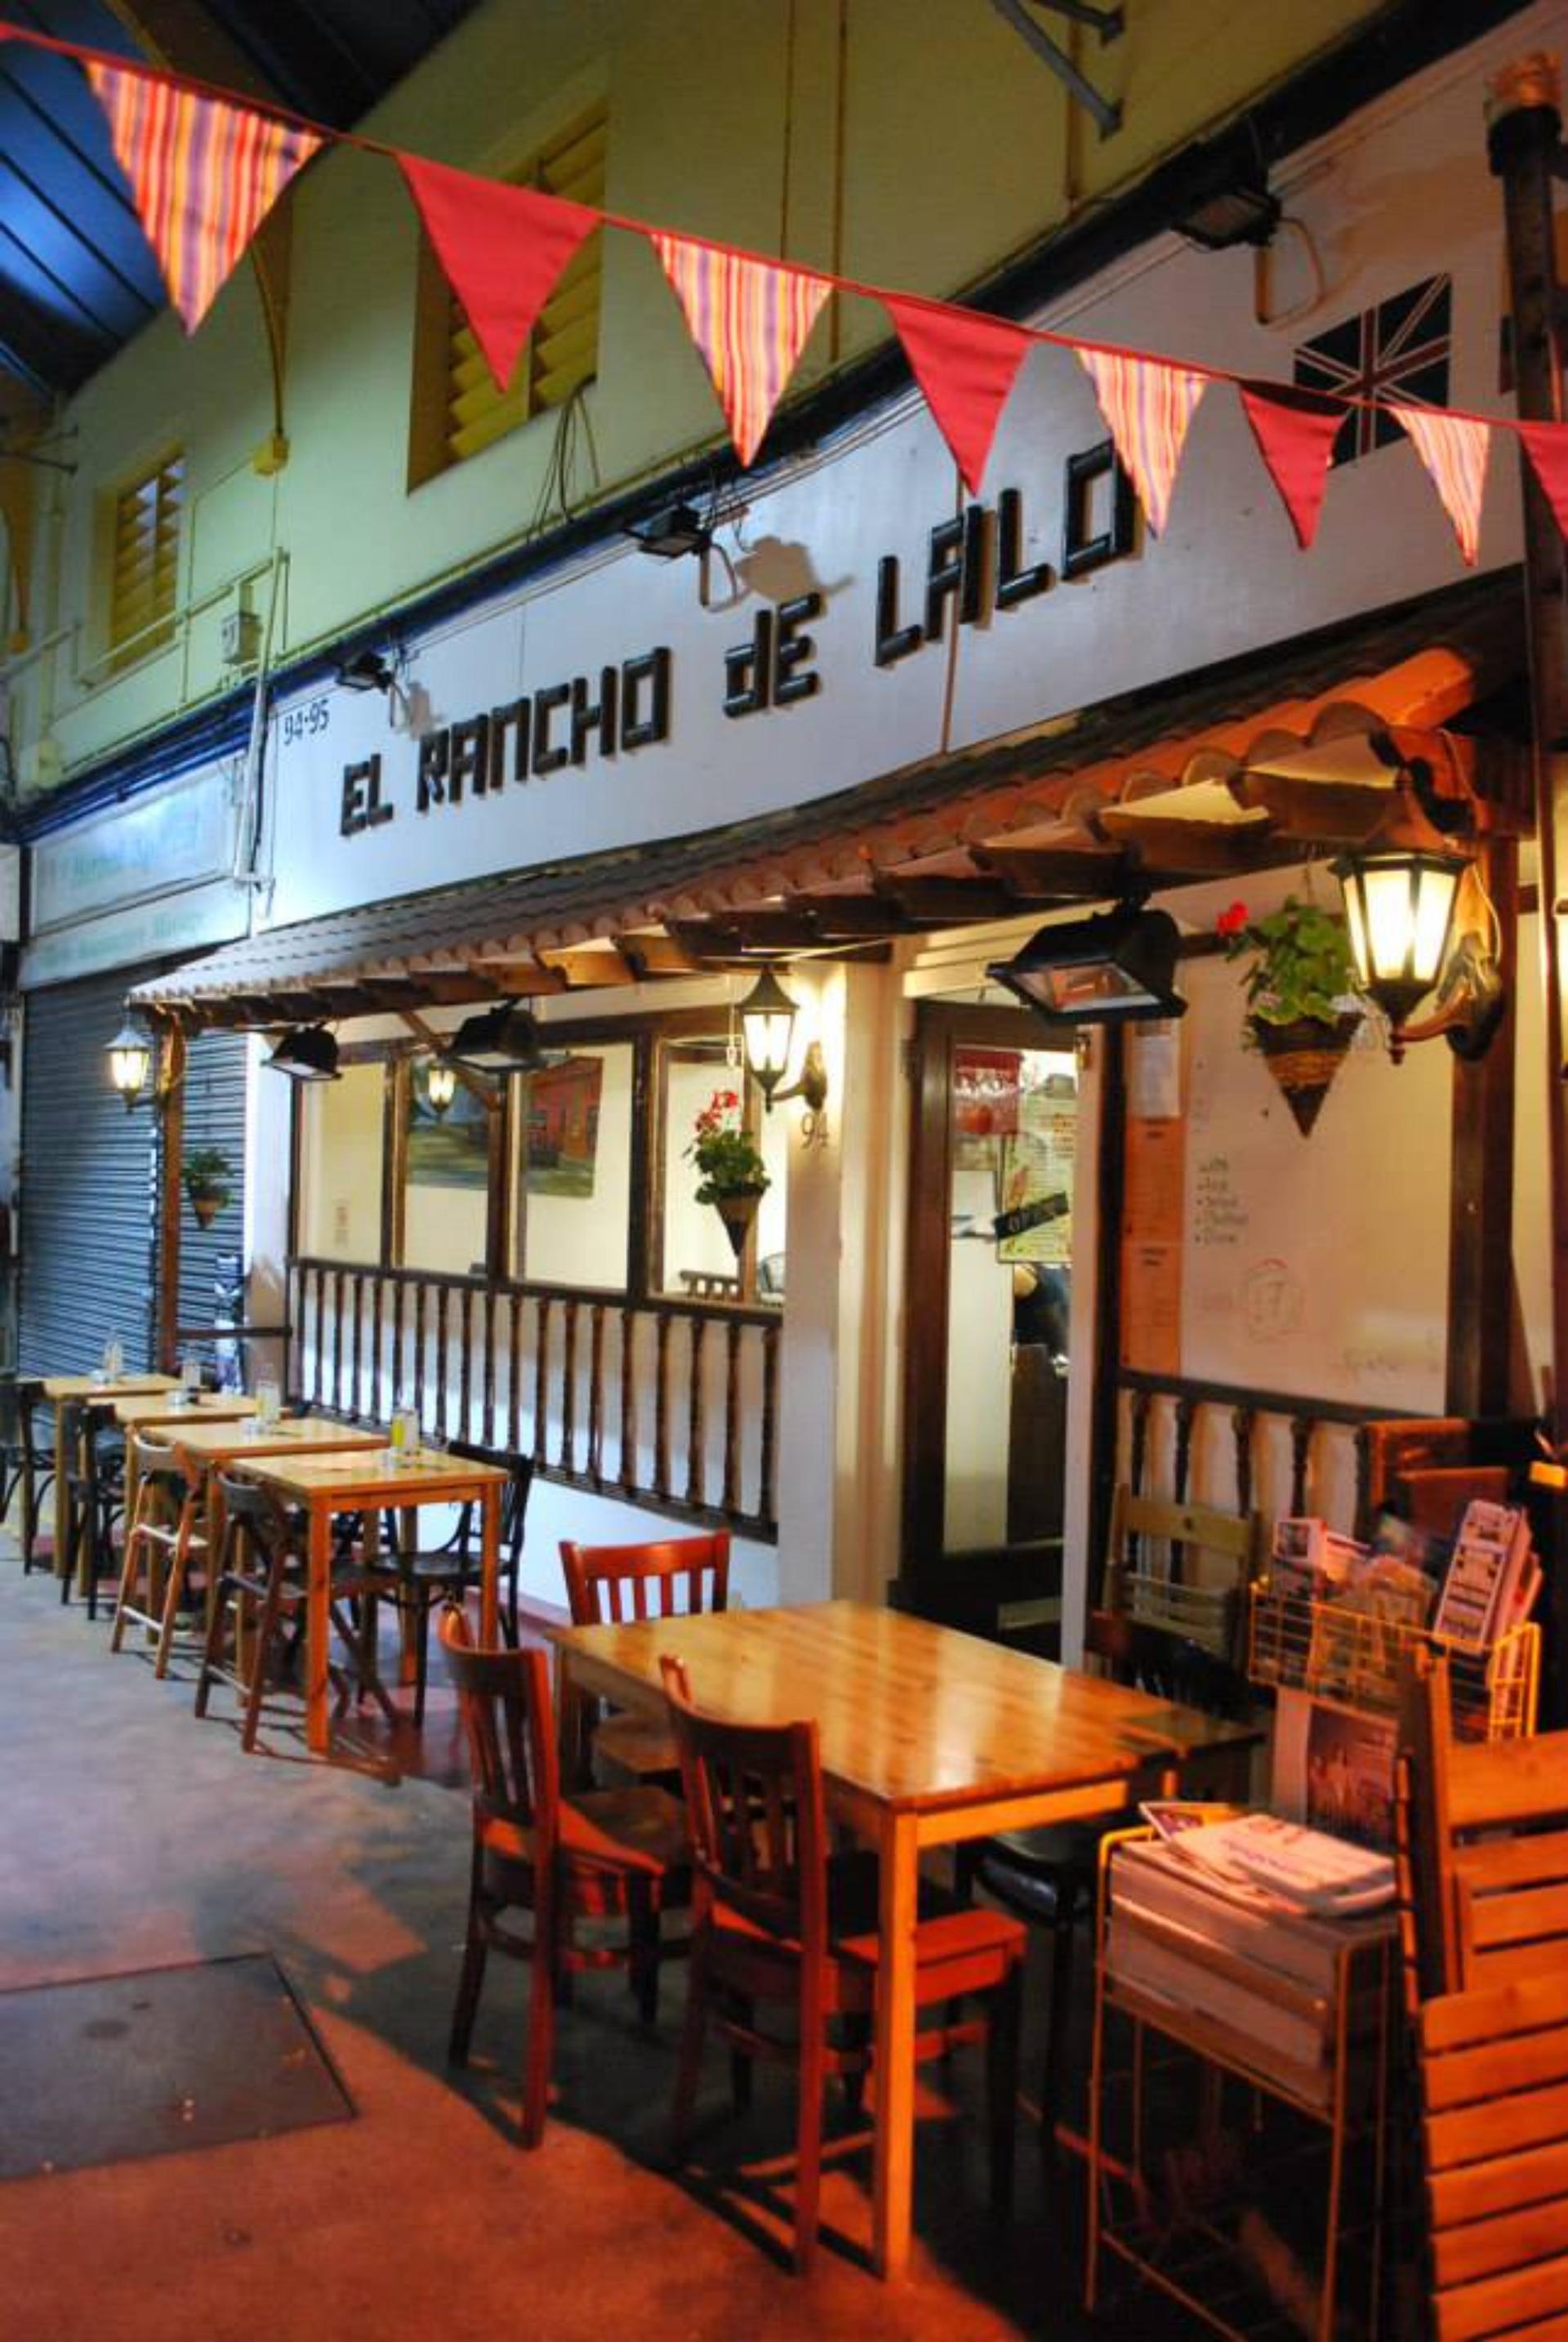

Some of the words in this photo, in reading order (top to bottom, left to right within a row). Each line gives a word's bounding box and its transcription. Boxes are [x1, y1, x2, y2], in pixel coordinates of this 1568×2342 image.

[341, 753, 394, 836] EL
[416, 646, 671, 813] RANCHO
[874, 439, 1136, 667] LALO
